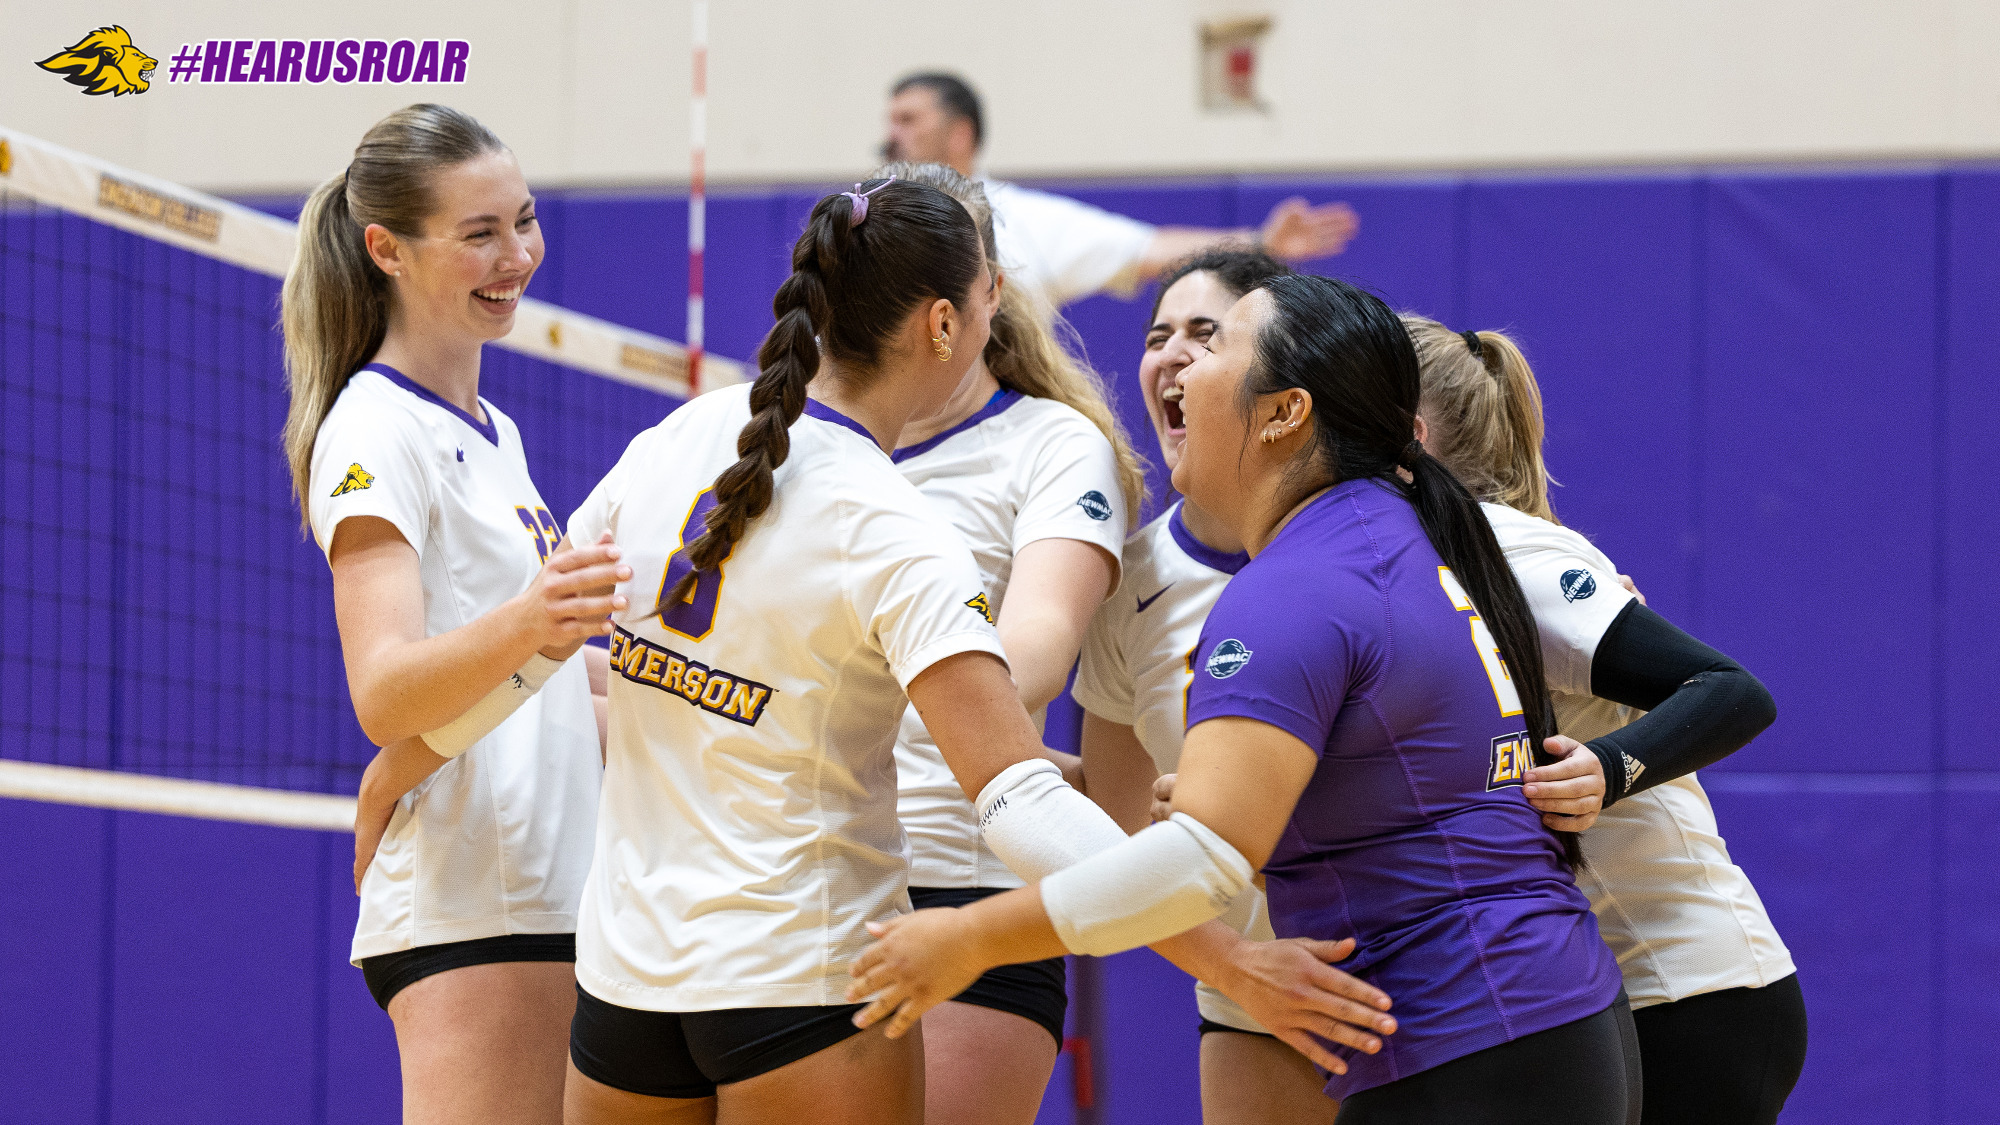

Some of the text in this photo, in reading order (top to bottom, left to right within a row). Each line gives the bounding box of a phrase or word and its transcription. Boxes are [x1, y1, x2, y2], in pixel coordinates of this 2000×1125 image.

[1077, 496, 1112, 516] NEWMAC
[1564, 570, 1591, 602] NEWMAC
[609, 633, 768, 720] EMERSON
[1207, 652, 1250, 668] NEWMAC
[1492, 737, 1537, 783] EM
[1620, 750, 1634, 793] adidas
